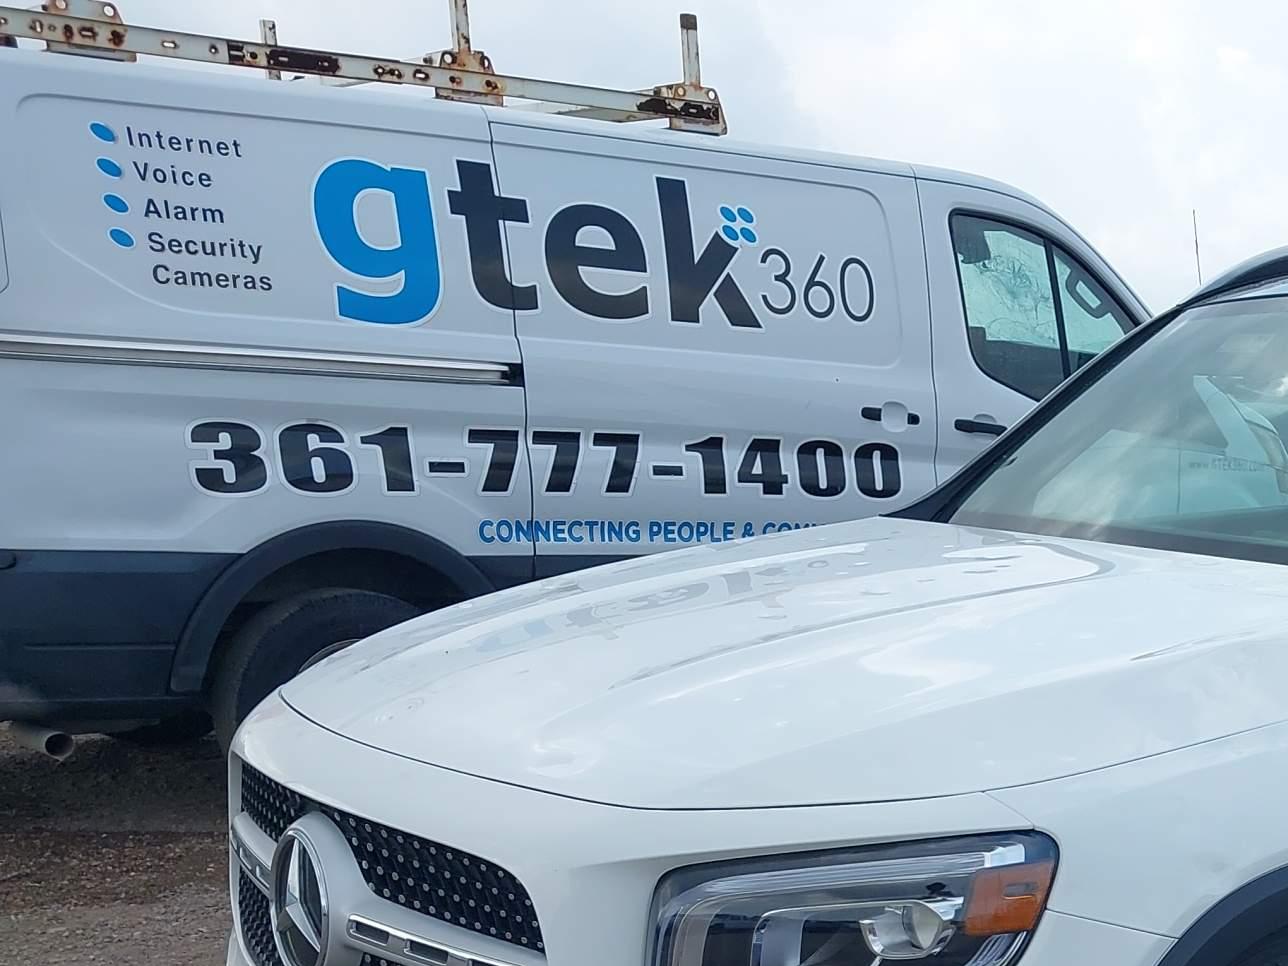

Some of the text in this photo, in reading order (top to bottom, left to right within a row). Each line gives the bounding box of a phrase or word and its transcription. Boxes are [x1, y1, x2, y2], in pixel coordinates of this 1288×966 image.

[126, 126, 242, 157] Internet
[132, 161, 213, 187] Voice
[144, 198, 225, 224] Alarm
[147, 232, 262, 264] Security
[152, 264, 273, 291] Cameras
[189, 422, 902, 498] 361-777-1400
[479, 520, 641, 543] CONNECTING
[650, 521, 735, 543] PEOPLE
[742, 522, 755, 539] &
